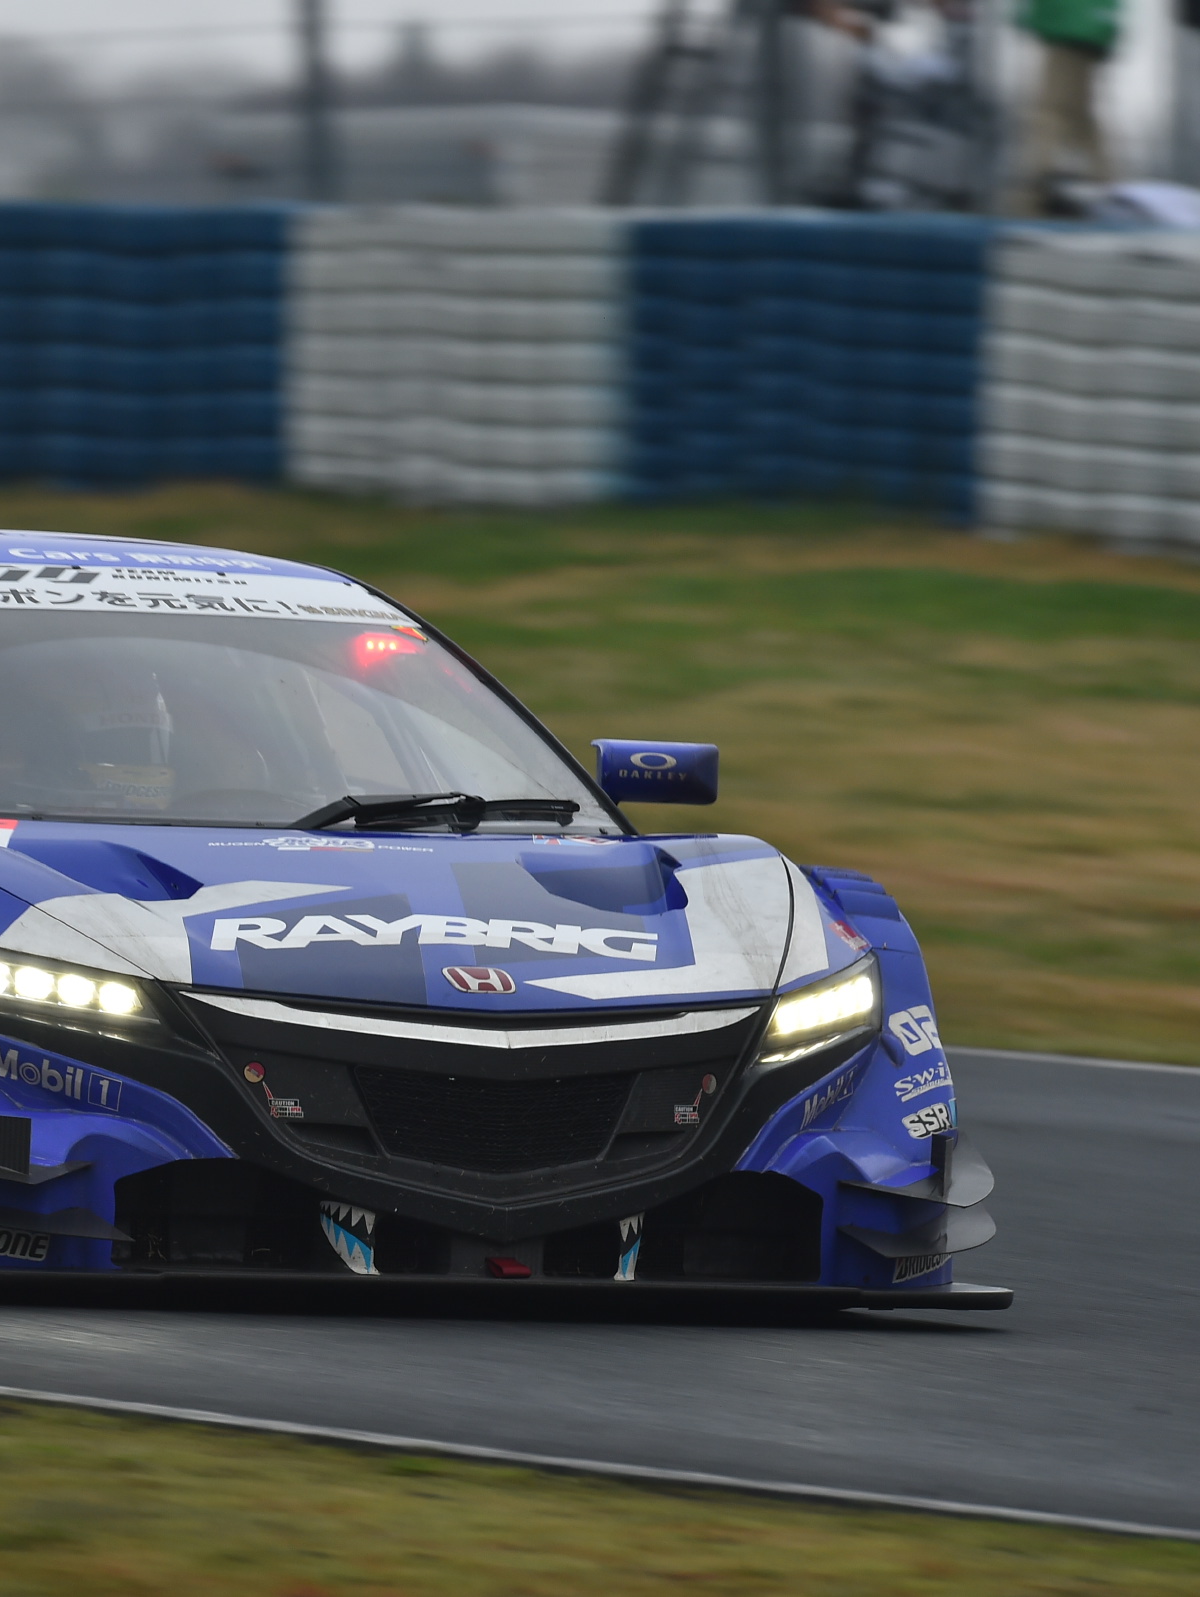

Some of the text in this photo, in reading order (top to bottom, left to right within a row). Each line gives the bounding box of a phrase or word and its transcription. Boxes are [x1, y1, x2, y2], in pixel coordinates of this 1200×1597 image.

[8, 548, 121, 562] Cars
[114, 568, 176, 576] TEAM
[618, 769, 687, 781] OAKLEY
[210, 914, 658, 962] RAYBRIG
[99, 1079, 110, 1106] 1
[902, 1103, 951, 1139] SSR
